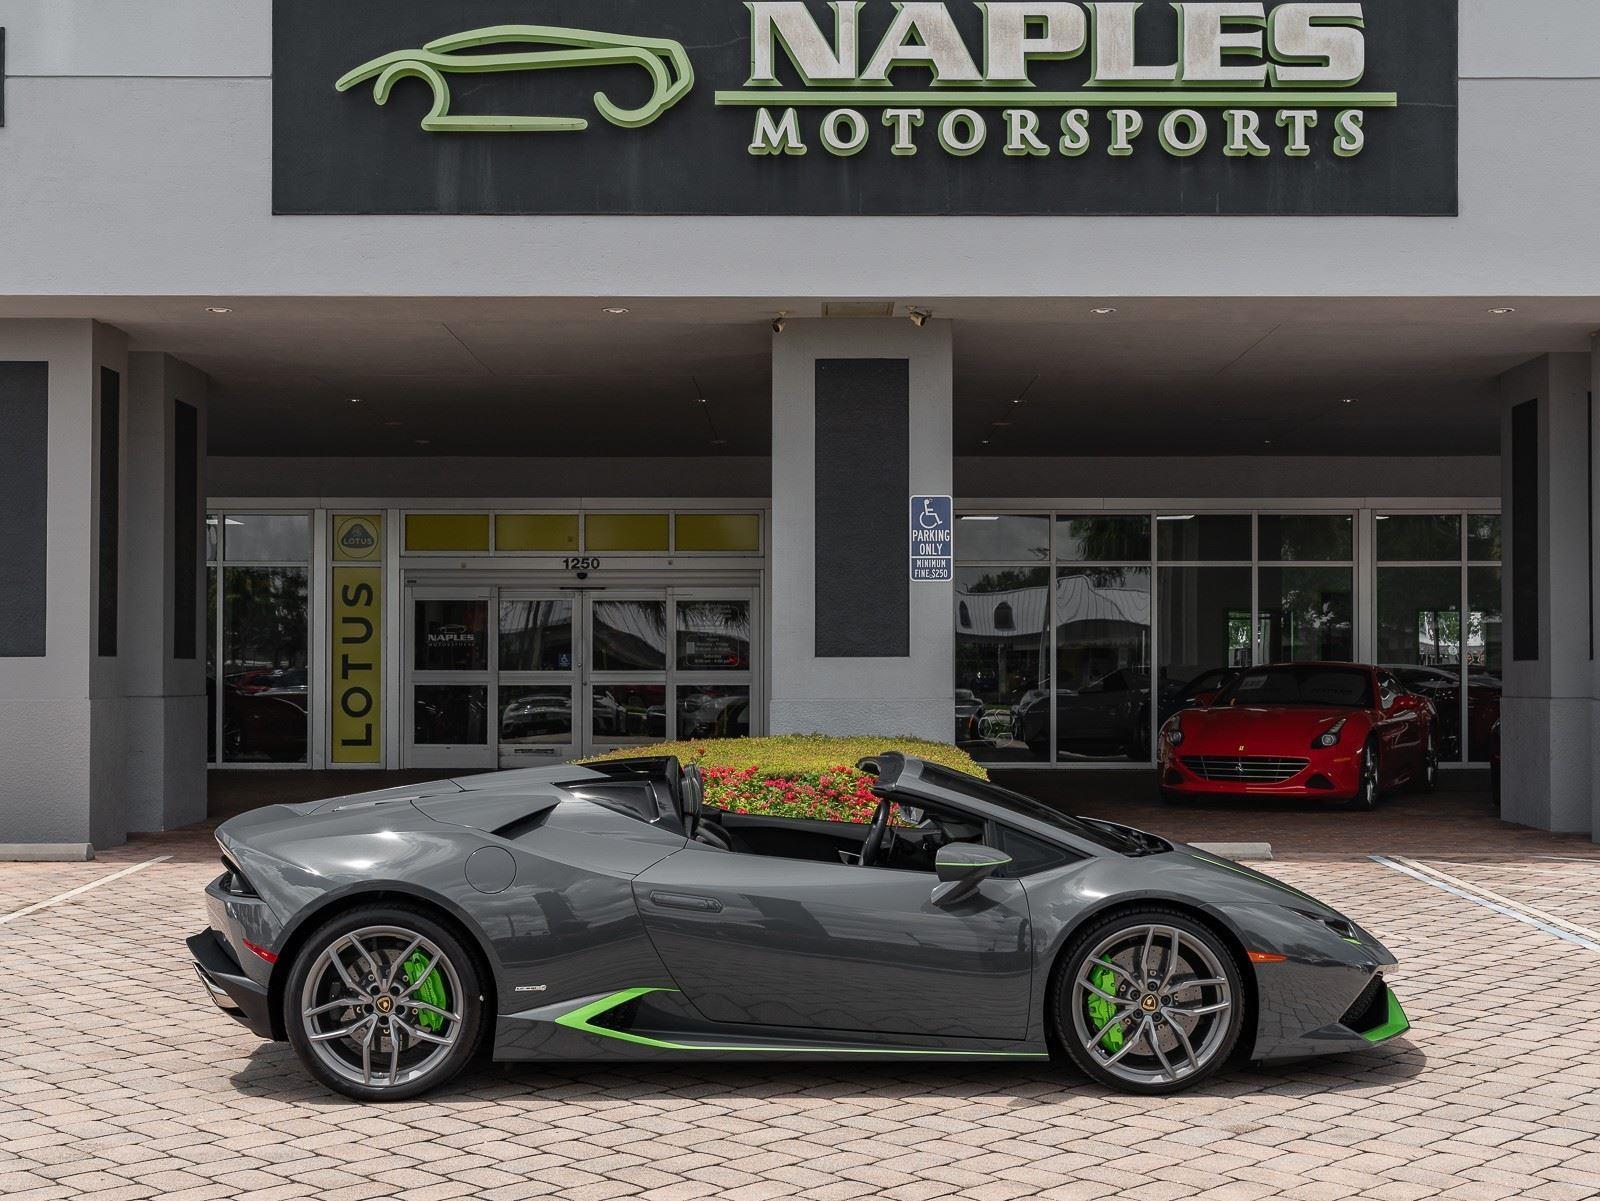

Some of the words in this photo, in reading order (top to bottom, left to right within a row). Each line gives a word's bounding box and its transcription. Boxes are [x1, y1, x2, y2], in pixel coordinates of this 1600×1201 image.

[743, 1, 1365, 87] NAPLES
[748, 108, 1365, 156] MOTORSPORTS
[912, 529, 950, 541] PARKING
[343, 537, 373, 546] LOTUS
[919, 544, 943, 555] ONLY
[563, 557, 601, 570] 1250
[916, 559, 946, 568] MINIMUM
[914, 569, 929, 578] FINE
[931, 569, 948, 578] $250
[341, 582, 373, 746] LOTUS
